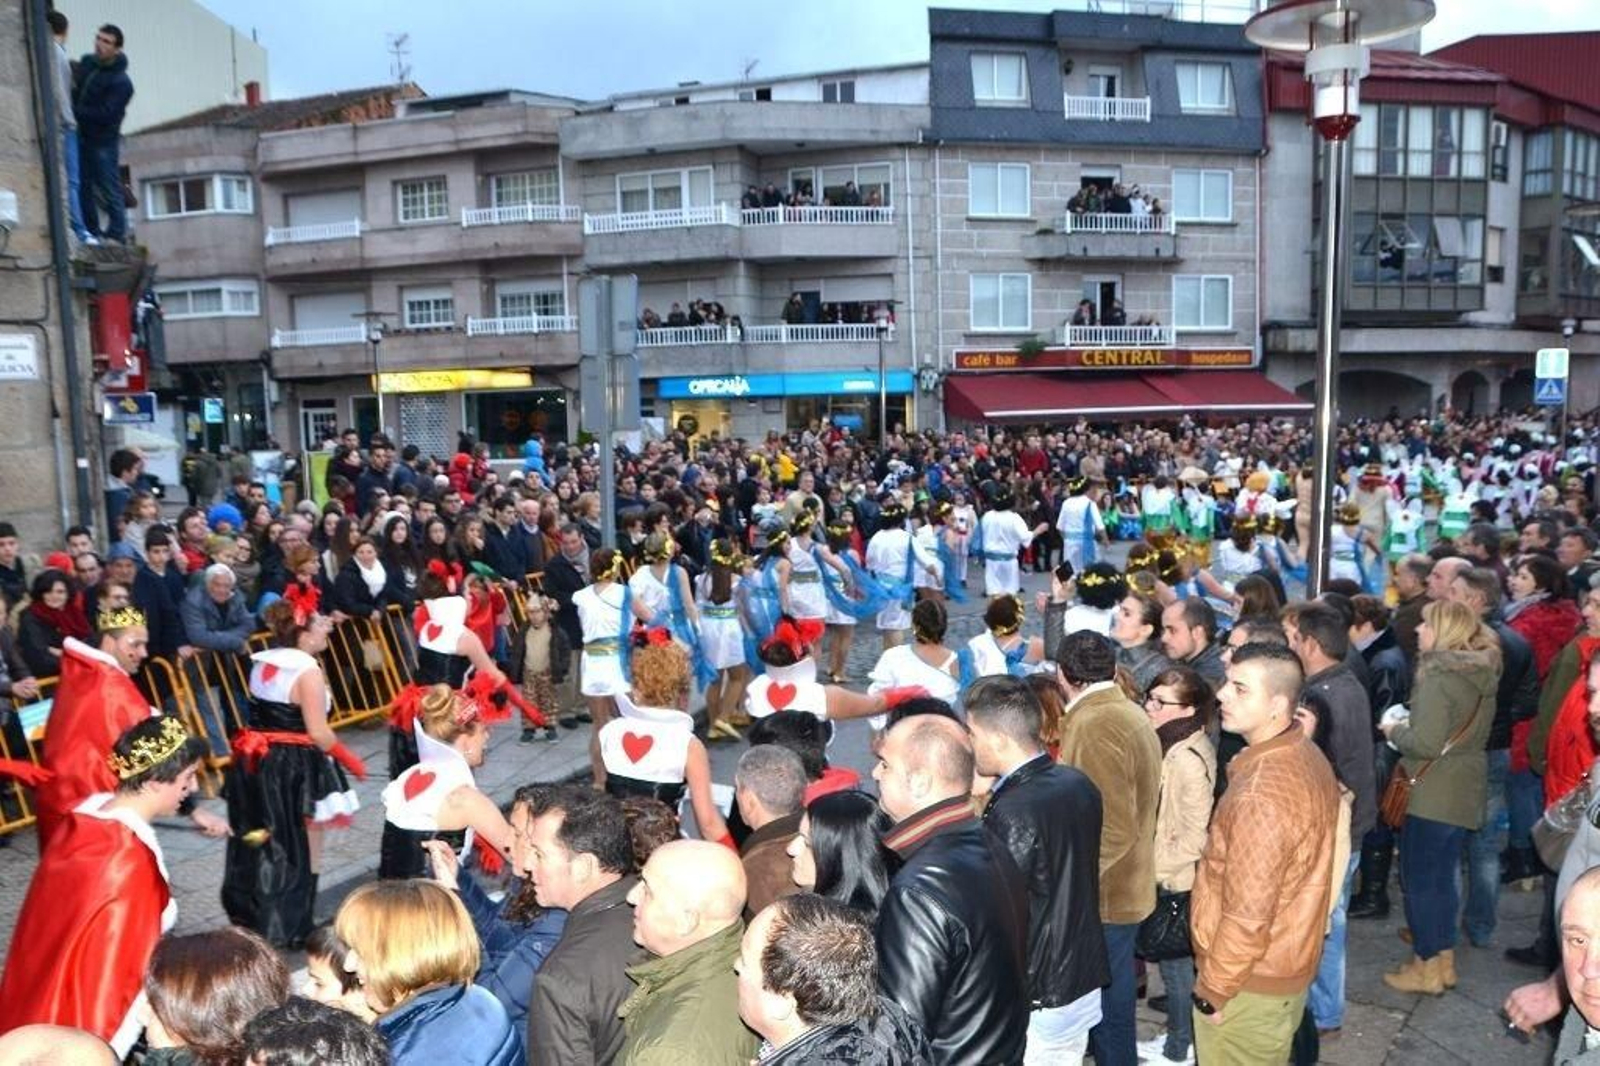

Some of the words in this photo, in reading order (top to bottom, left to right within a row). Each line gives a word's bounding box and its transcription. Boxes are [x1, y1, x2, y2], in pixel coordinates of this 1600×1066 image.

[963, 354, 991, 365] café
[996, 354, 1018, 365] bar
[1081, 350, 1165, 365] CENTRAL
